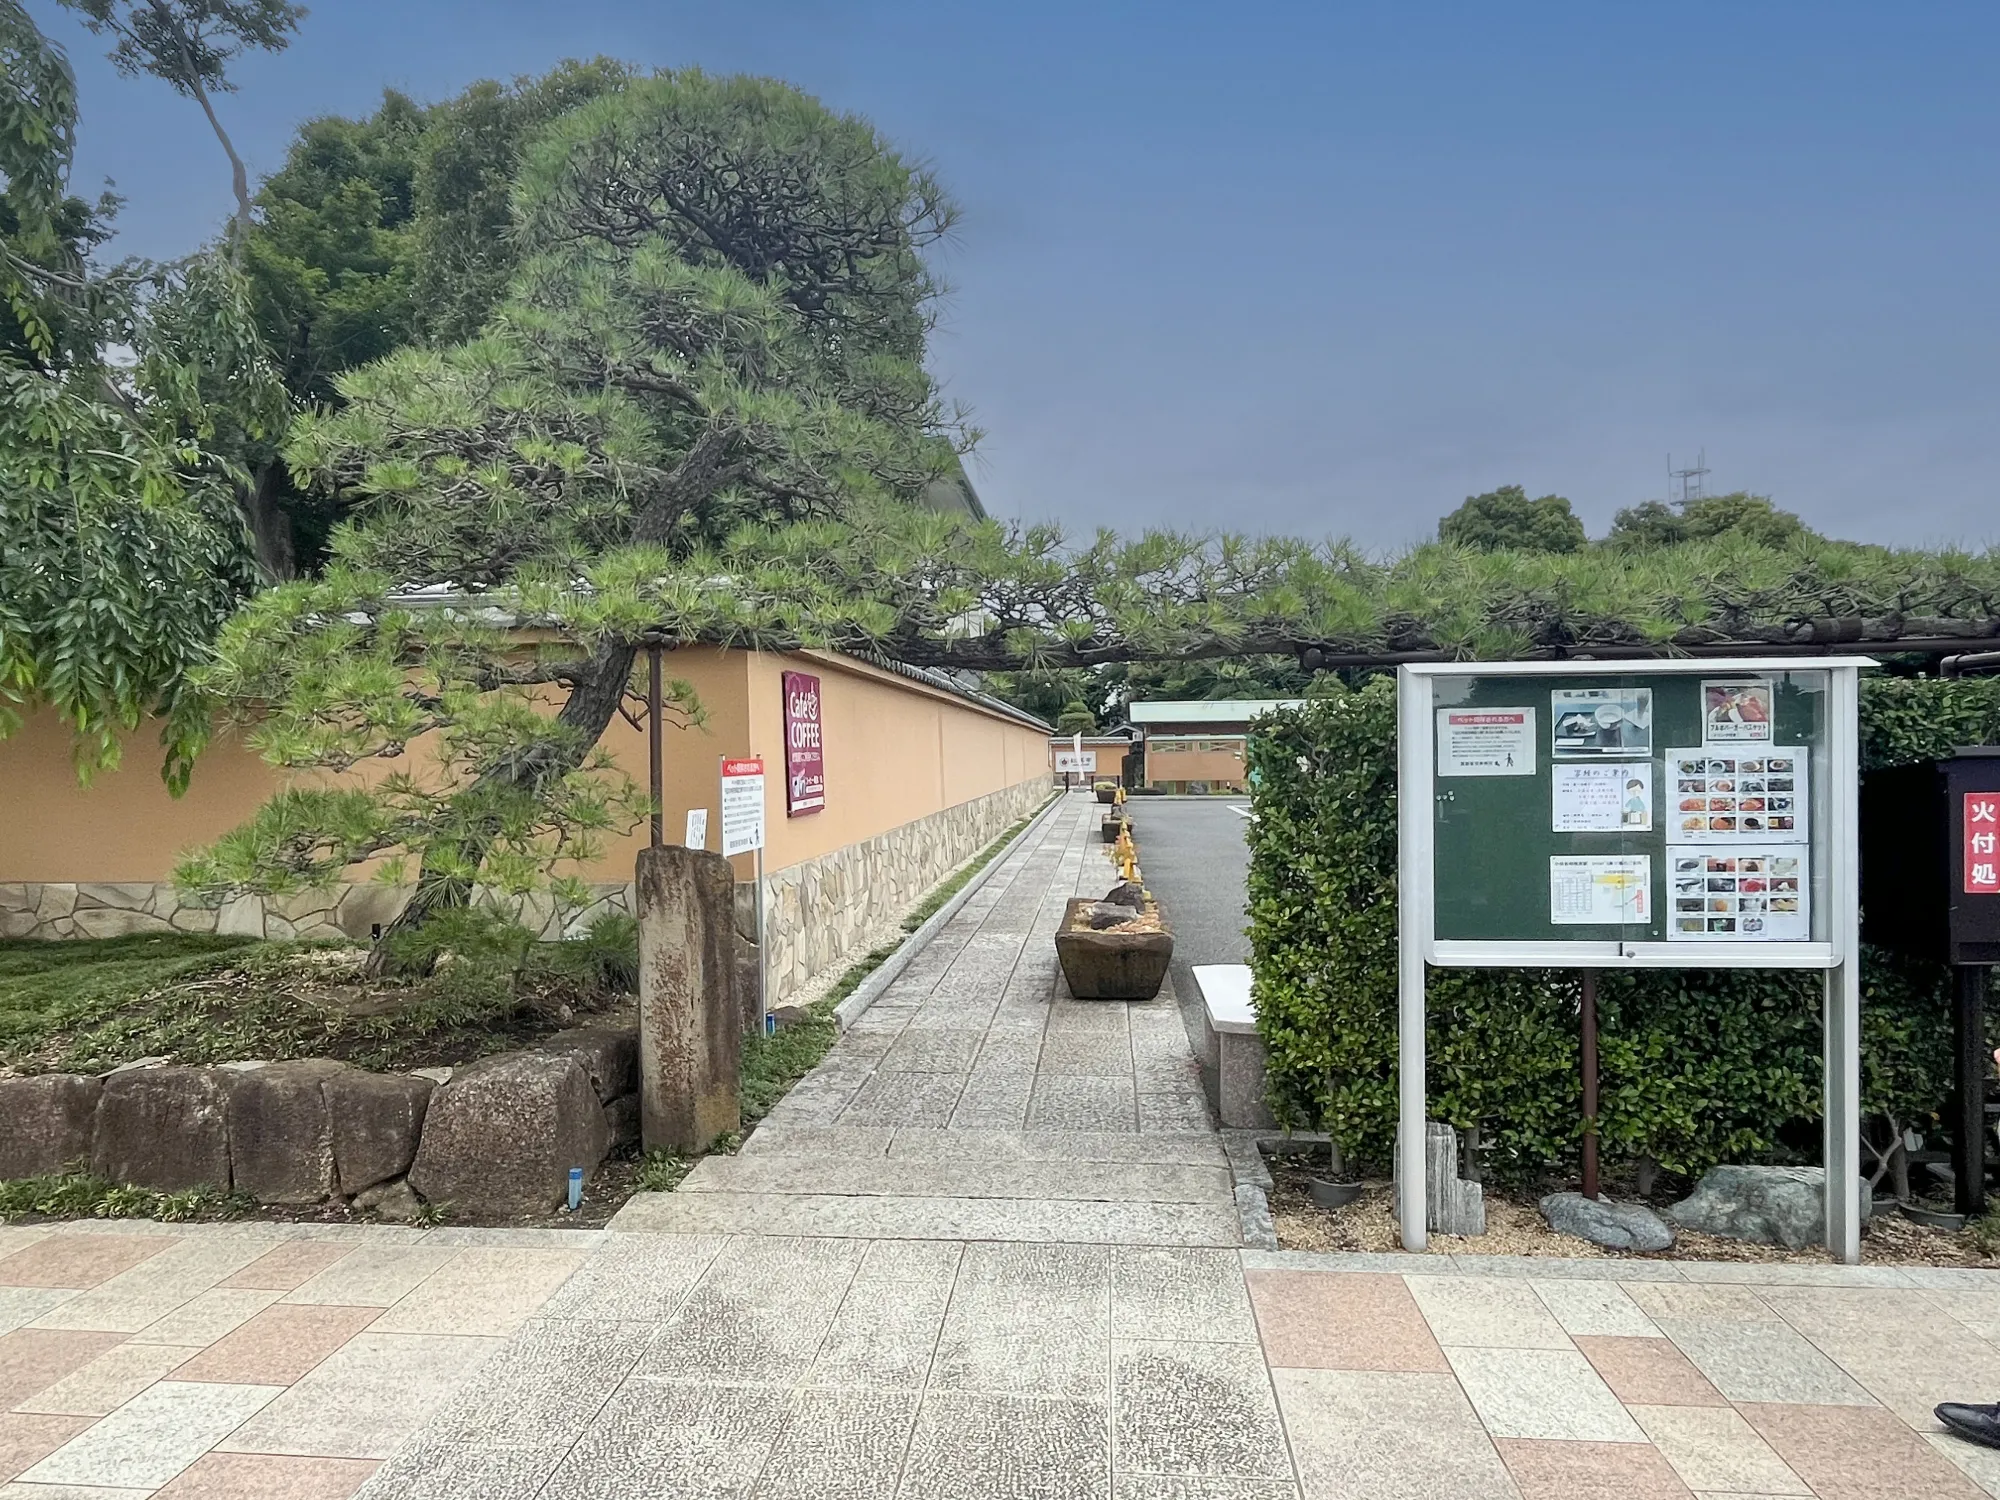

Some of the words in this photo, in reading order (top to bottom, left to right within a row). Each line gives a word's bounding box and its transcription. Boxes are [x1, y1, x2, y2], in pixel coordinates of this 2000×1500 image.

[790, 691, 809, 719] Café
[791, 721, 820, 749] COFFEE
[1971, 801, 1997, 885] 火付処
